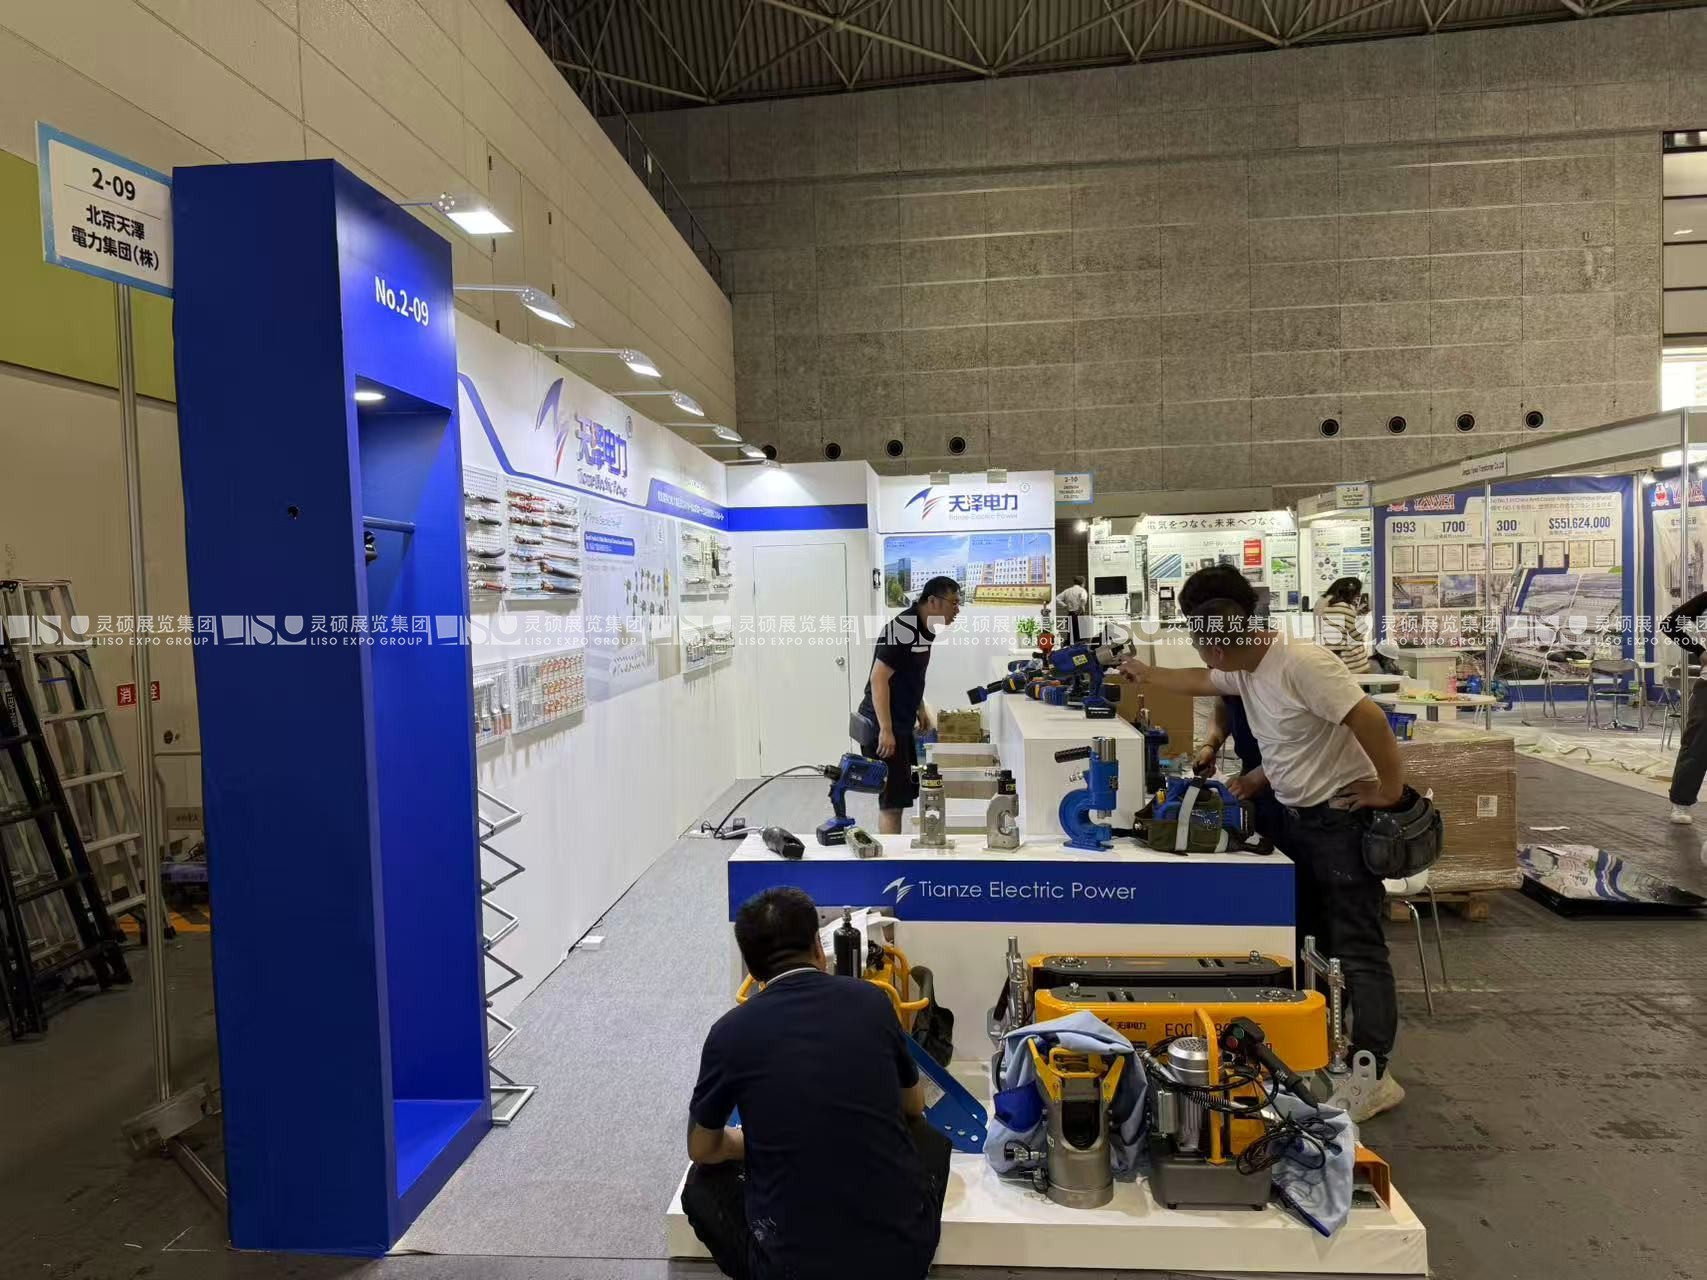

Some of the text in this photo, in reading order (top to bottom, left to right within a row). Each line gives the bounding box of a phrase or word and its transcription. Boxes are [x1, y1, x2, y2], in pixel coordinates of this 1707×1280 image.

[92, 168, 135, 201] 2-09
[86, 204, 145, 240] 北京天澤
[71, 225, 159, 271] 電力集団(株)
[375, 275, 429, 326] No.2-09
[948, 493, 1018, 513] 天泽电力
[1392, 521, 1416, 532] 1993
[1442, 521, 1466, 533] 1700
[1496, 520, 1517, 531] 300
[919, 881, 1137, 900] Tianze Electric Power
